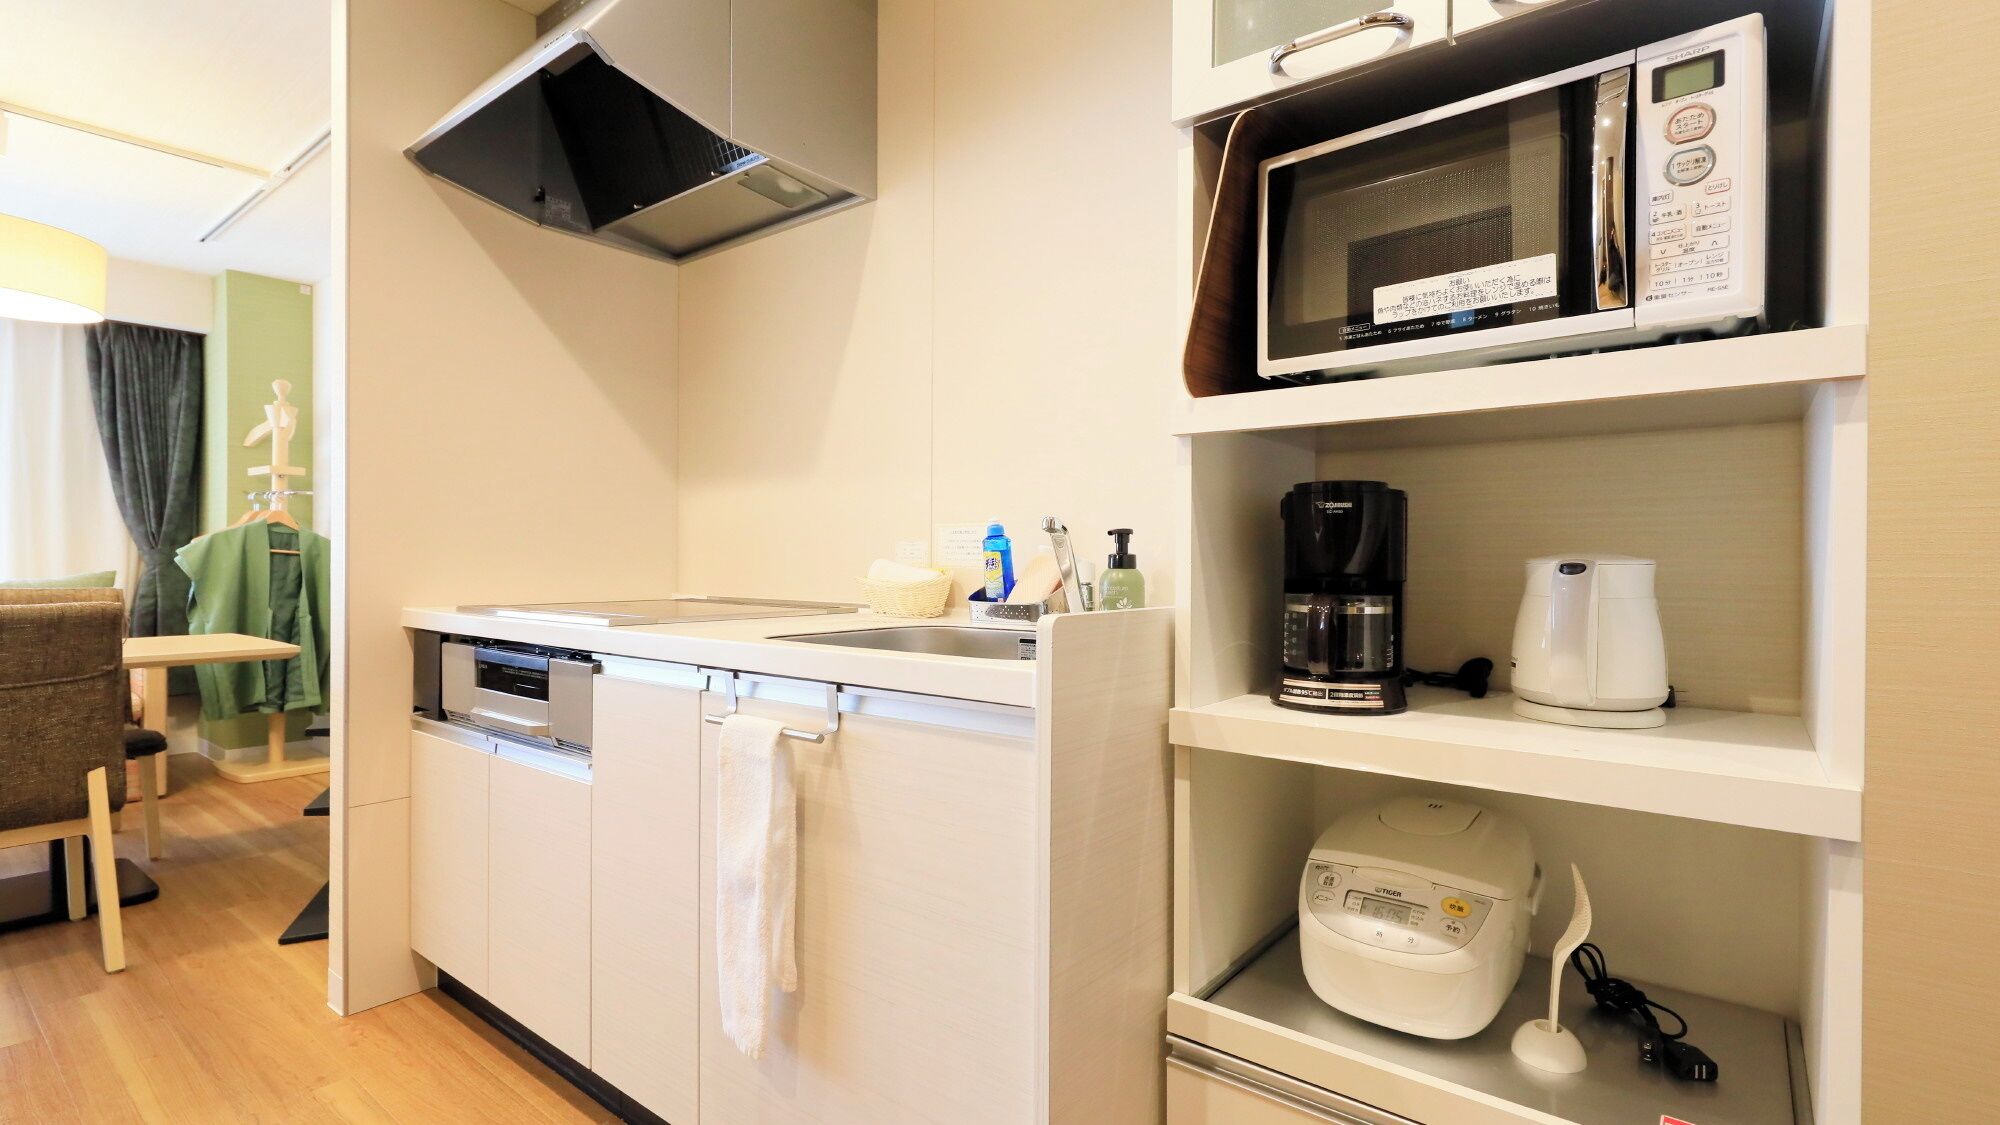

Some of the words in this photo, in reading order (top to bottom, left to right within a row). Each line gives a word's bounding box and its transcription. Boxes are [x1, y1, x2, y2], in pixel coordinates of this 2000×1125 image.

[1666, 45, 1710, 62] SHARP
[1674, 112, 1705, 125] あたため
[1675, 119, 1703, 131] スタート
[1448, 277, 1470, 287] お願い
[1382, 888, 1402, 898] TIGER
[1445, 924, 1461, 934] 予約
